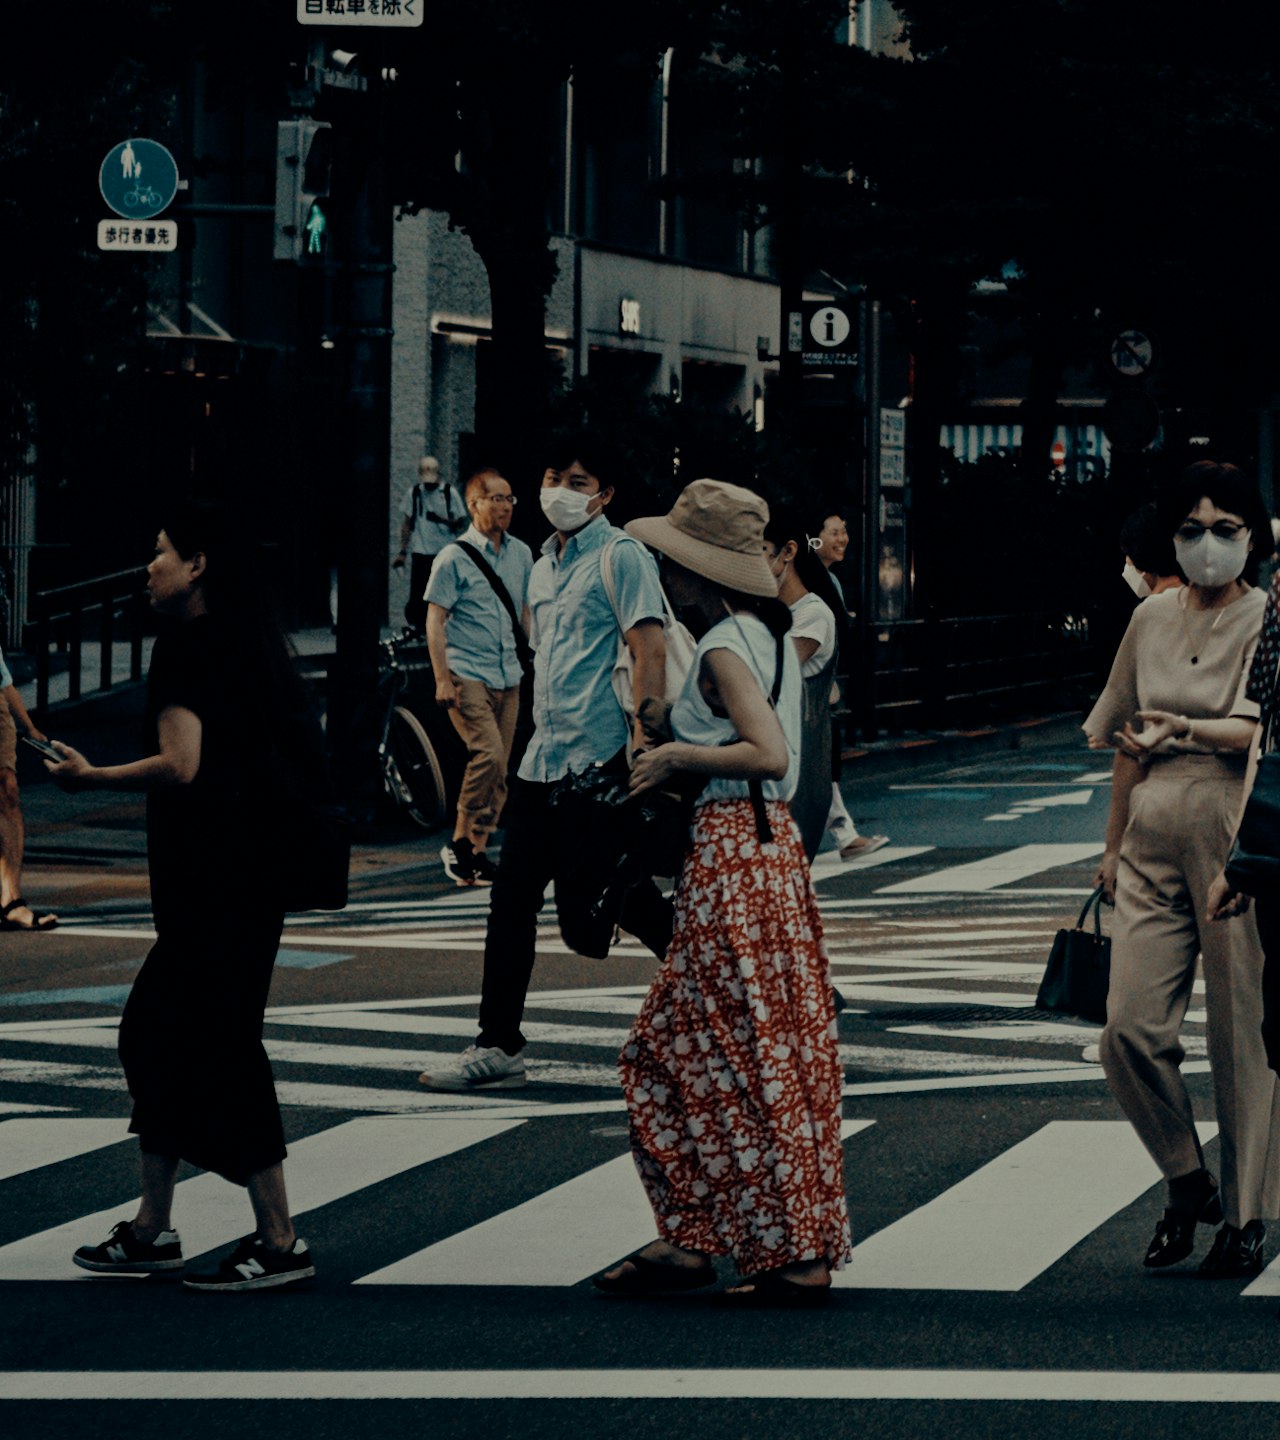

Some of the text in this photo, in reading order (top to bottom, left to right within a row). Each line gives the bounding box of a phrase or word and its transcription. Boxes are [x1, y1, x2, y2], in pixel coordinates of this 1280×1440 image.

[105, 226, 170, 245] 歩行者優先
